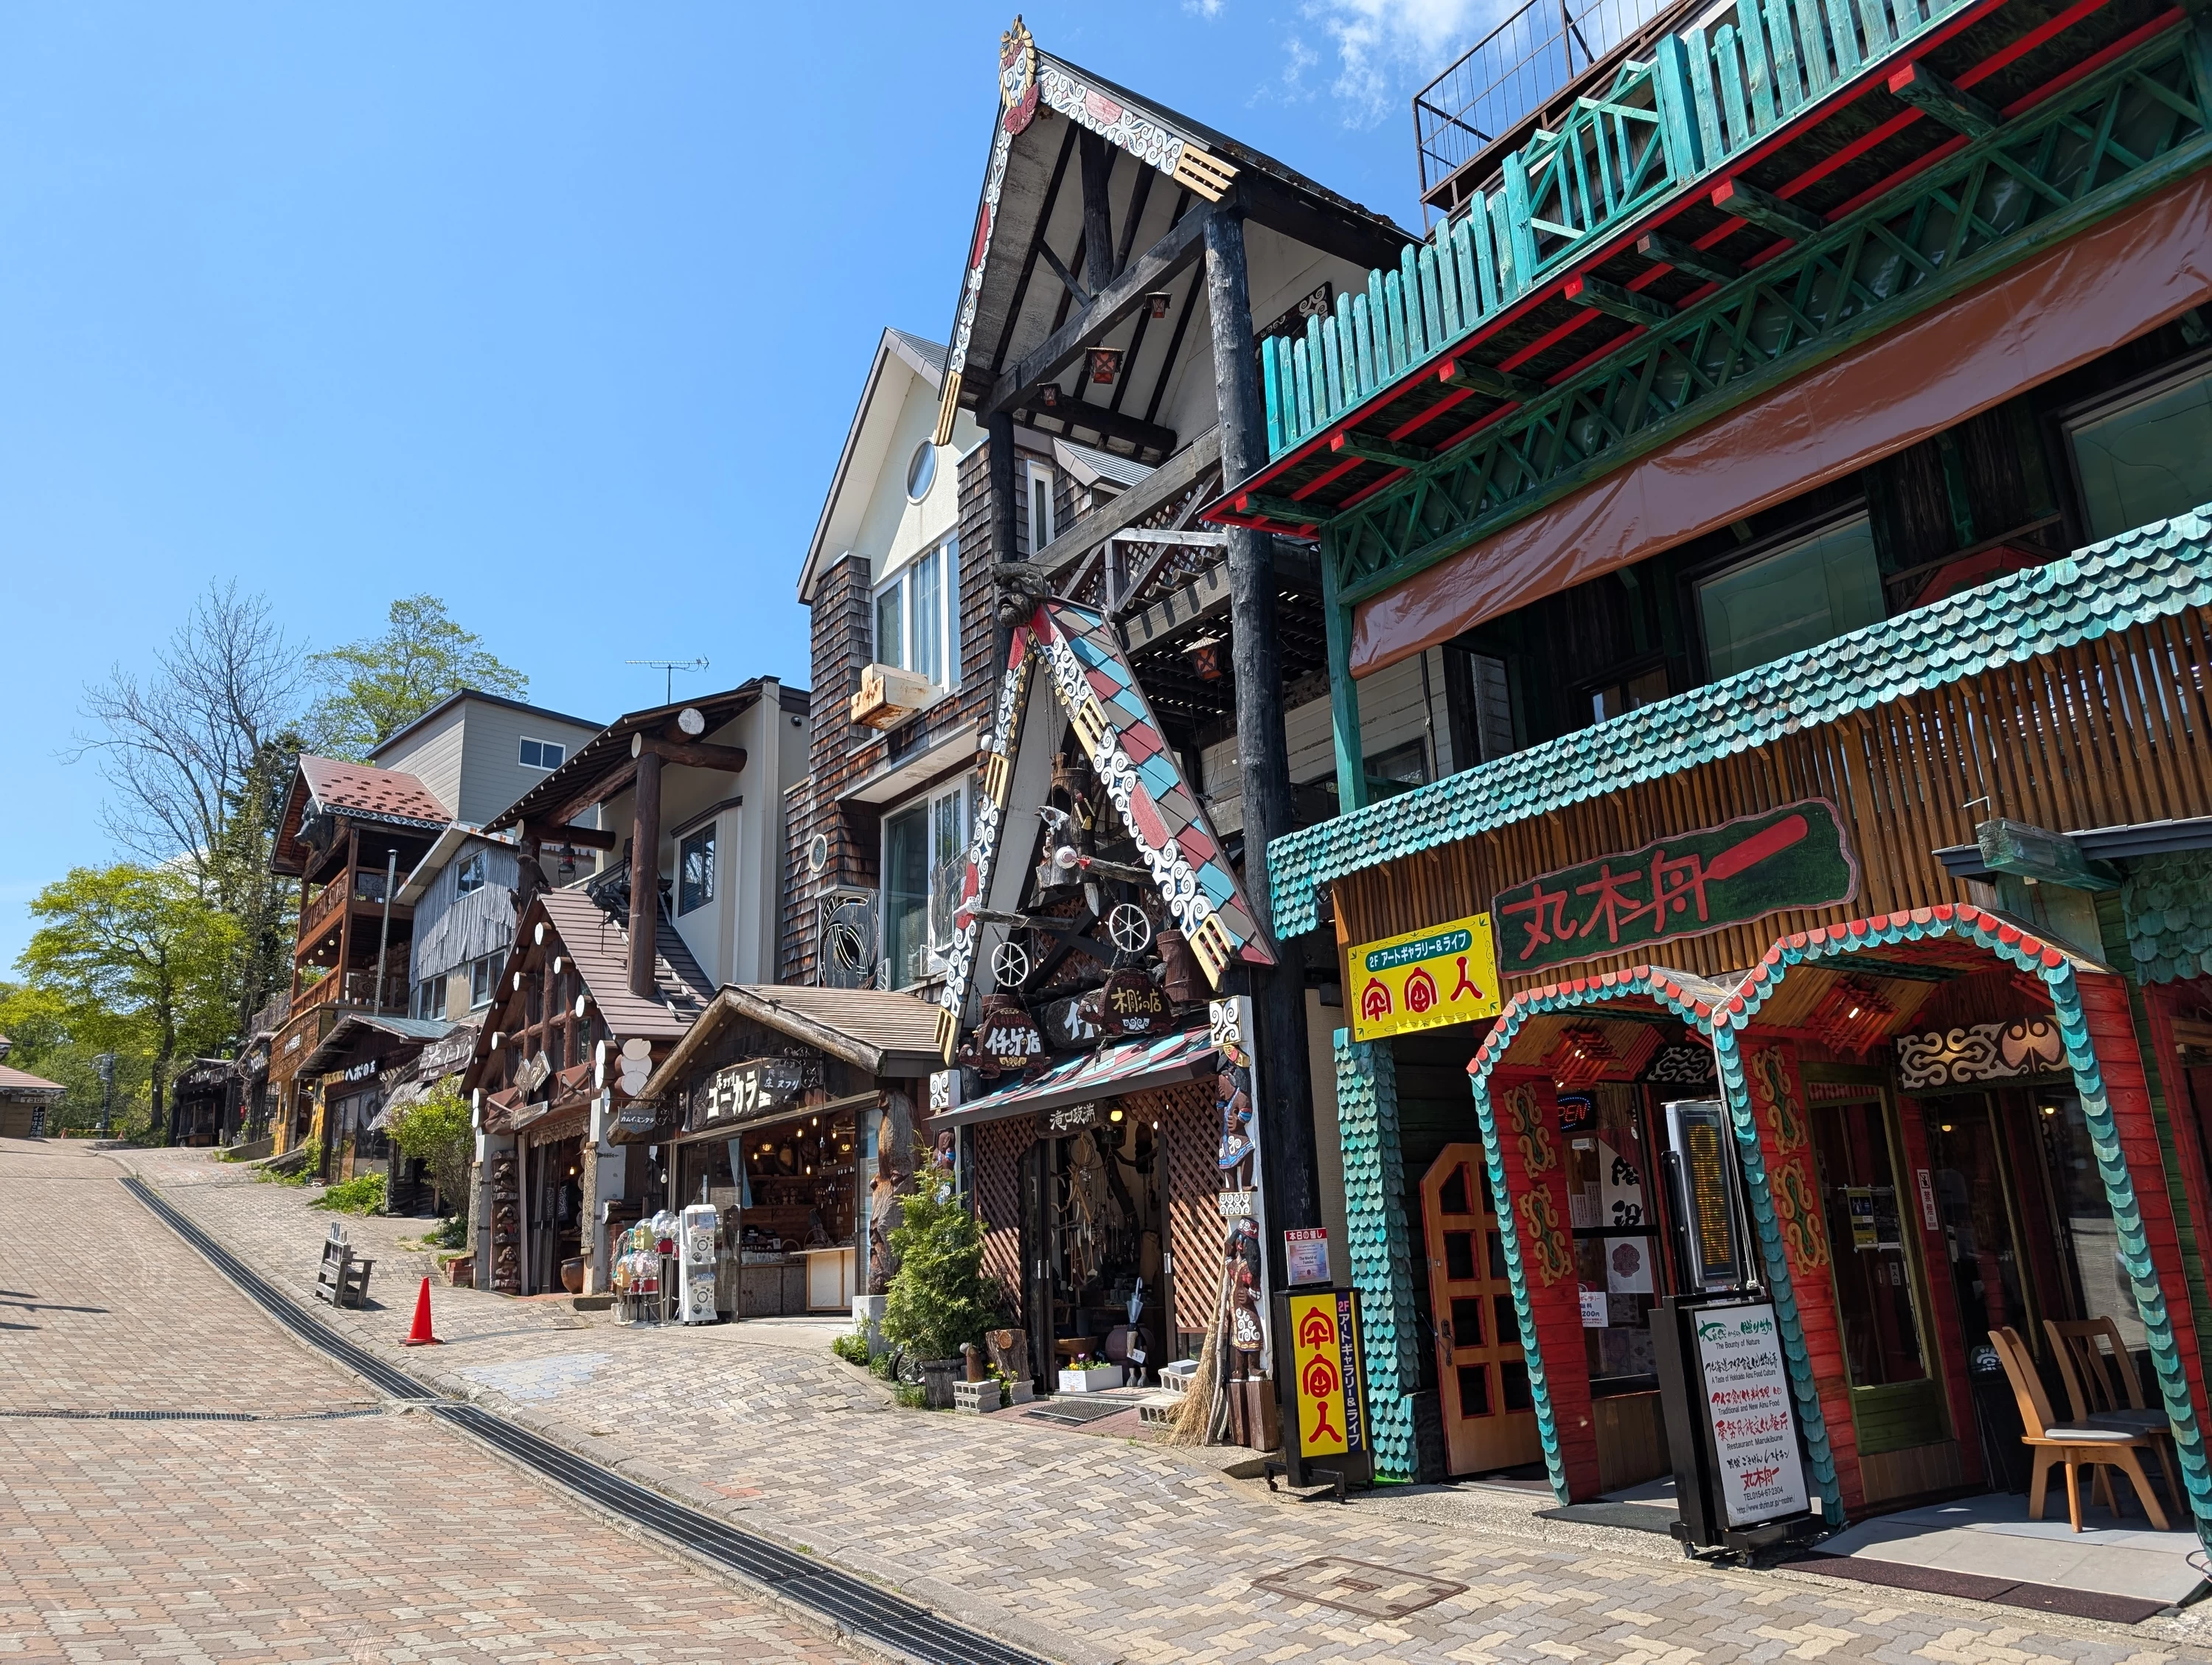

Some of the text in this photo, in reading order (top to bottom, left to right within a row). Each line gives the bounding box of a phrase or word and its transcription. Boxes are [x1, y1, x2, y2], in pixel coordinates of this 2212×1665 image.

[1502, 816, 1806, 959] 丸木舟
[1369, 932, 1467, 967] 2F アートギャラリー&ライブ
[1110, 987, 1162, 1014] 木彫の店
[1557, 1103, 1587, 1122] PEN
[1290, 1229, 1323, 1241] 本日の催し
[1338, 1301, 1349, 1313] 2F
[1715, 1342, 1724, 1350] The
[1338, 1313, 1360, 1447] アートギャラリー&ライブ
[1730, 1373, 1745, 1381] Hokkaido
[1718, 1399, 1780, 1416] Traditional and New Ainu Food
[1726, 1434, 1784, 1451] Restaurant Marukibune
[1740, 1465, 1780, 1492] 丸木舟
